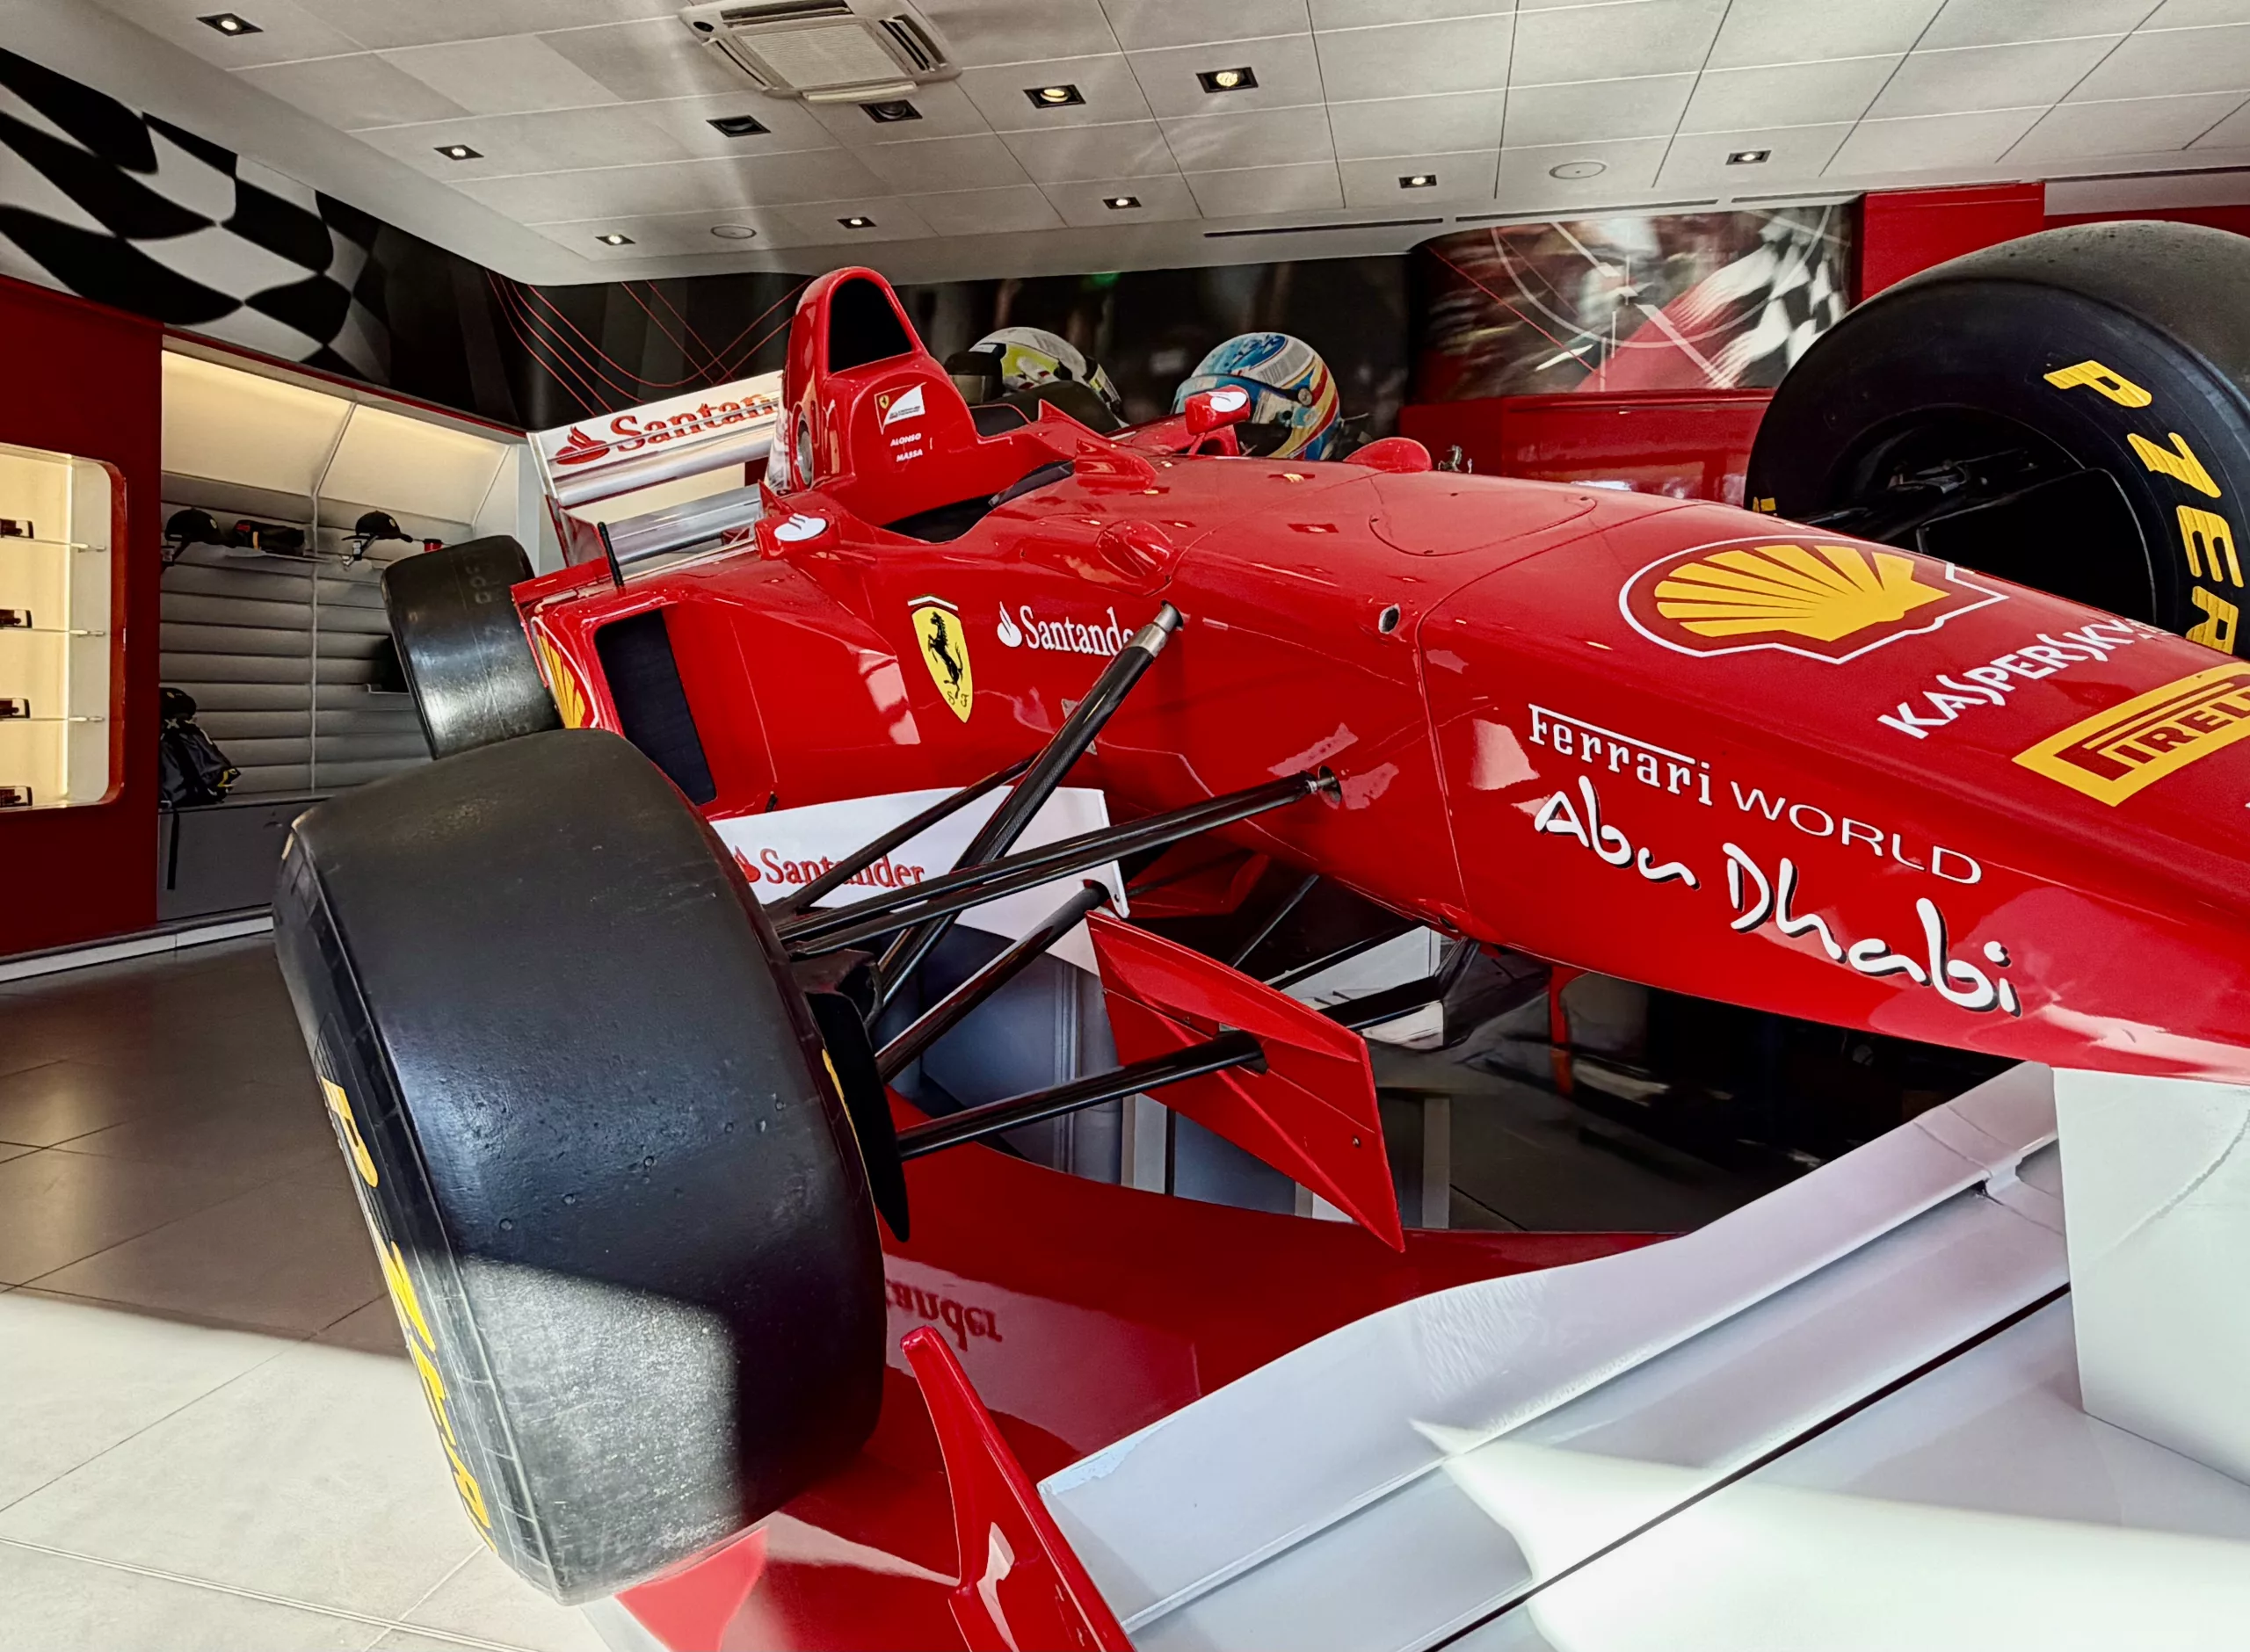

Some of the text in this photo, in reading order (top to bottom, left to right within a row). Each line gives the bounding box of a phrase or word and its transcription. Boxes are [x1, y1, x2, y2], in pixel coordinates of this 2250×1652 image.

[2043, 360, 2152, 408] P
[890, 433, 922, 446] ALONSO
[896, 449, 923, 462] MASSA
[1877, 619, 2136, 739] KASPERSKY
[1528, 704, 1983, 884] Ferrari WORLD
[760, 848, 925, 888] Santnder
[1534, 775, 2021, 1017] Abu Dhabi
[320, 1076, 379, 1188] P
